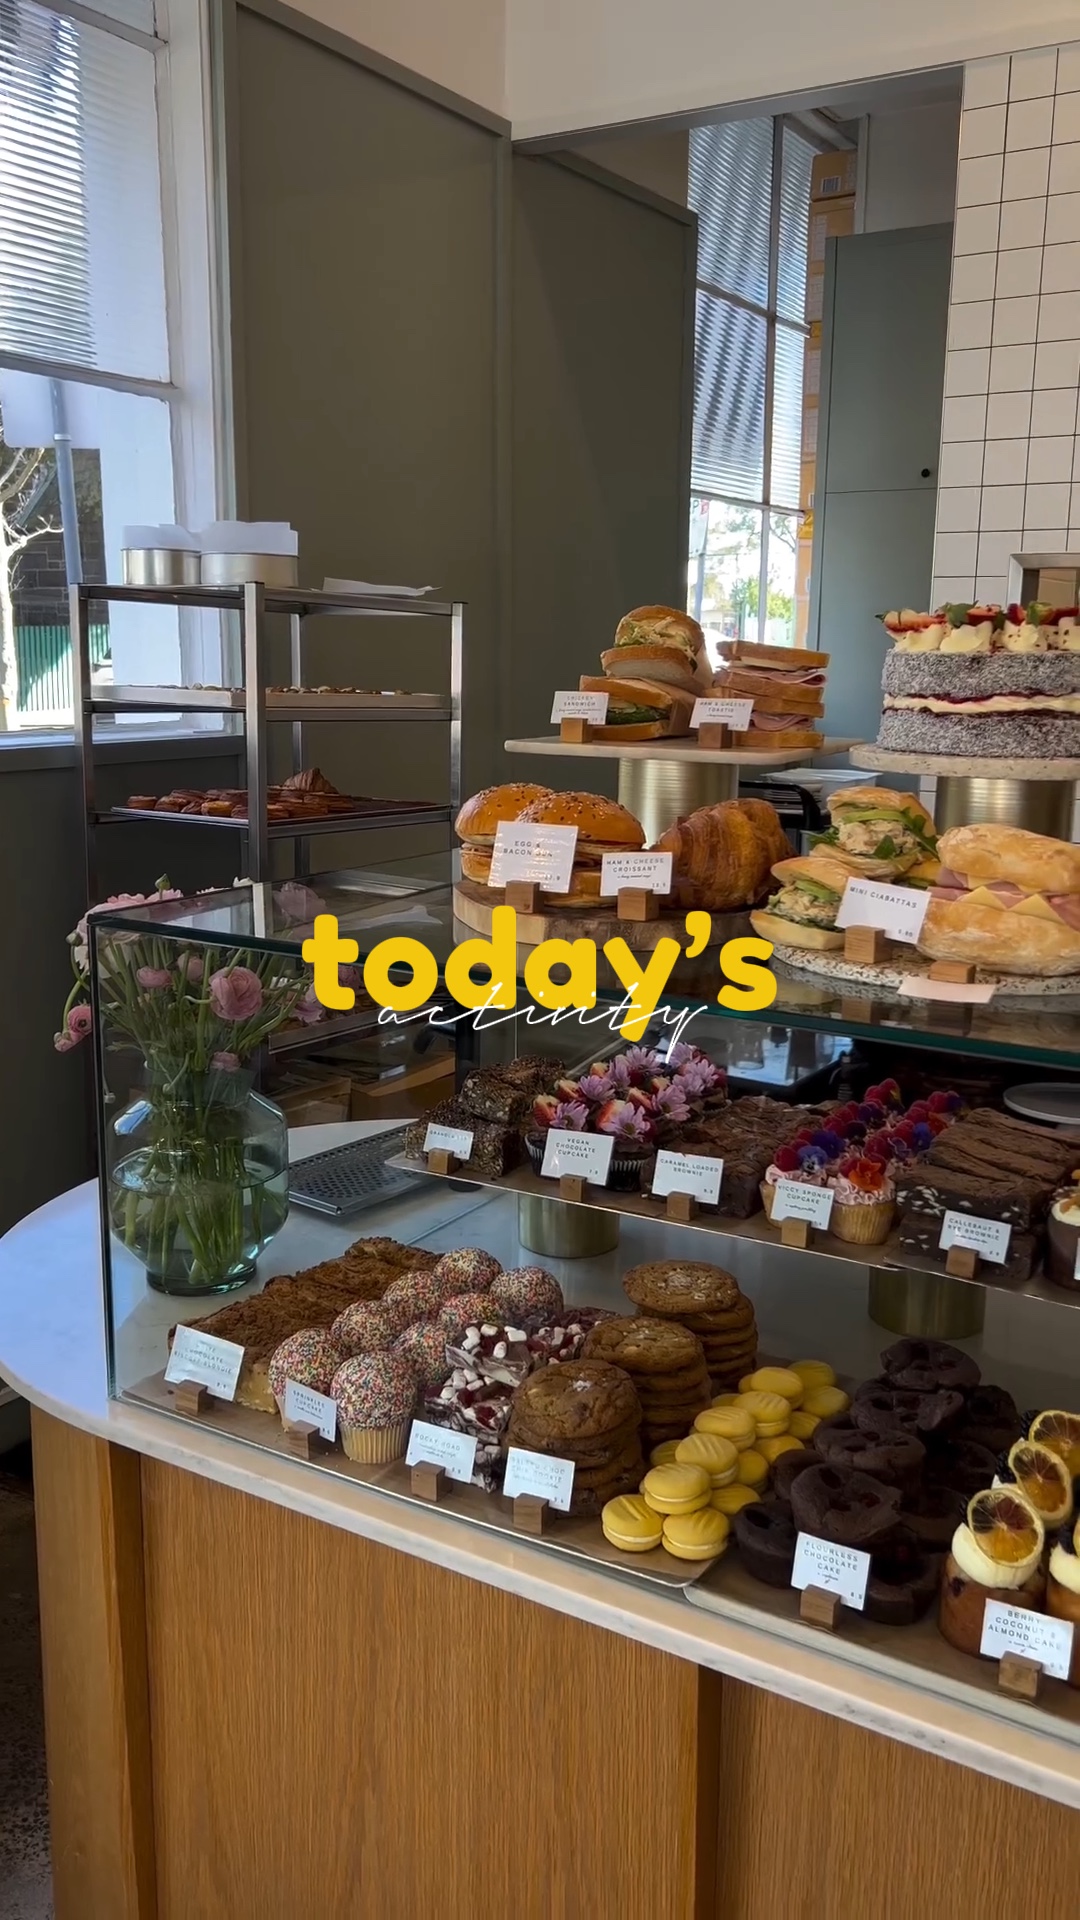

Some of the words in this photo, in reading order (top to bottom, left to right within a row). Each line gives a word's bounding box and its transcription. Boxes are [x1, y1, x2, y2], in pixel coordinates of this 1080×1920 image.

[514, 840, 532, 848] EGG
[503, 847, 532, 856] BACON
[633, 857, 665, 866] CHEESE
[612, 865, 658, 873] CROISSANT
[849, 886, 868, 896] MINI
[870, 890, 918, 909] CIABATTAS
[555, 1142, 596, 1154] CHOCOLATE
[567, 1138, 590, 1146] VEGAN
[557, 1149, 589, 1159] CUPCAKE
[660, 1158, 690, 1168] CARAMEL
[692, 1163, 719, 1173] LOADED
[673, 1166, 703, 1177] BROWNIE
[786, 1193, 820, 1205] CUPCAKE
[802, 1190, 832, 1201] SPONGE
[949, 1217, 992, 1231] CALLEBAUT
[947, 1224, 962, 1233] RYE
[964, 1227, 1000, 1241] BROWNIE
[415, 1432, 438, 1444] ROCKY
[806, 1541, 858, 1562] FLOURLESS
[804, 1549, 858, 1571] CHOCOLATE
[818, 1563, 841, 1575] CAKE
[1008, 1610, 1041, 1624] BERRY
[996, 1616, 1045, 1635] COCONUT
[988, 1624, 1030, 1641] ALMOND
[1034, 1637, 1062, 1651] CAKE
